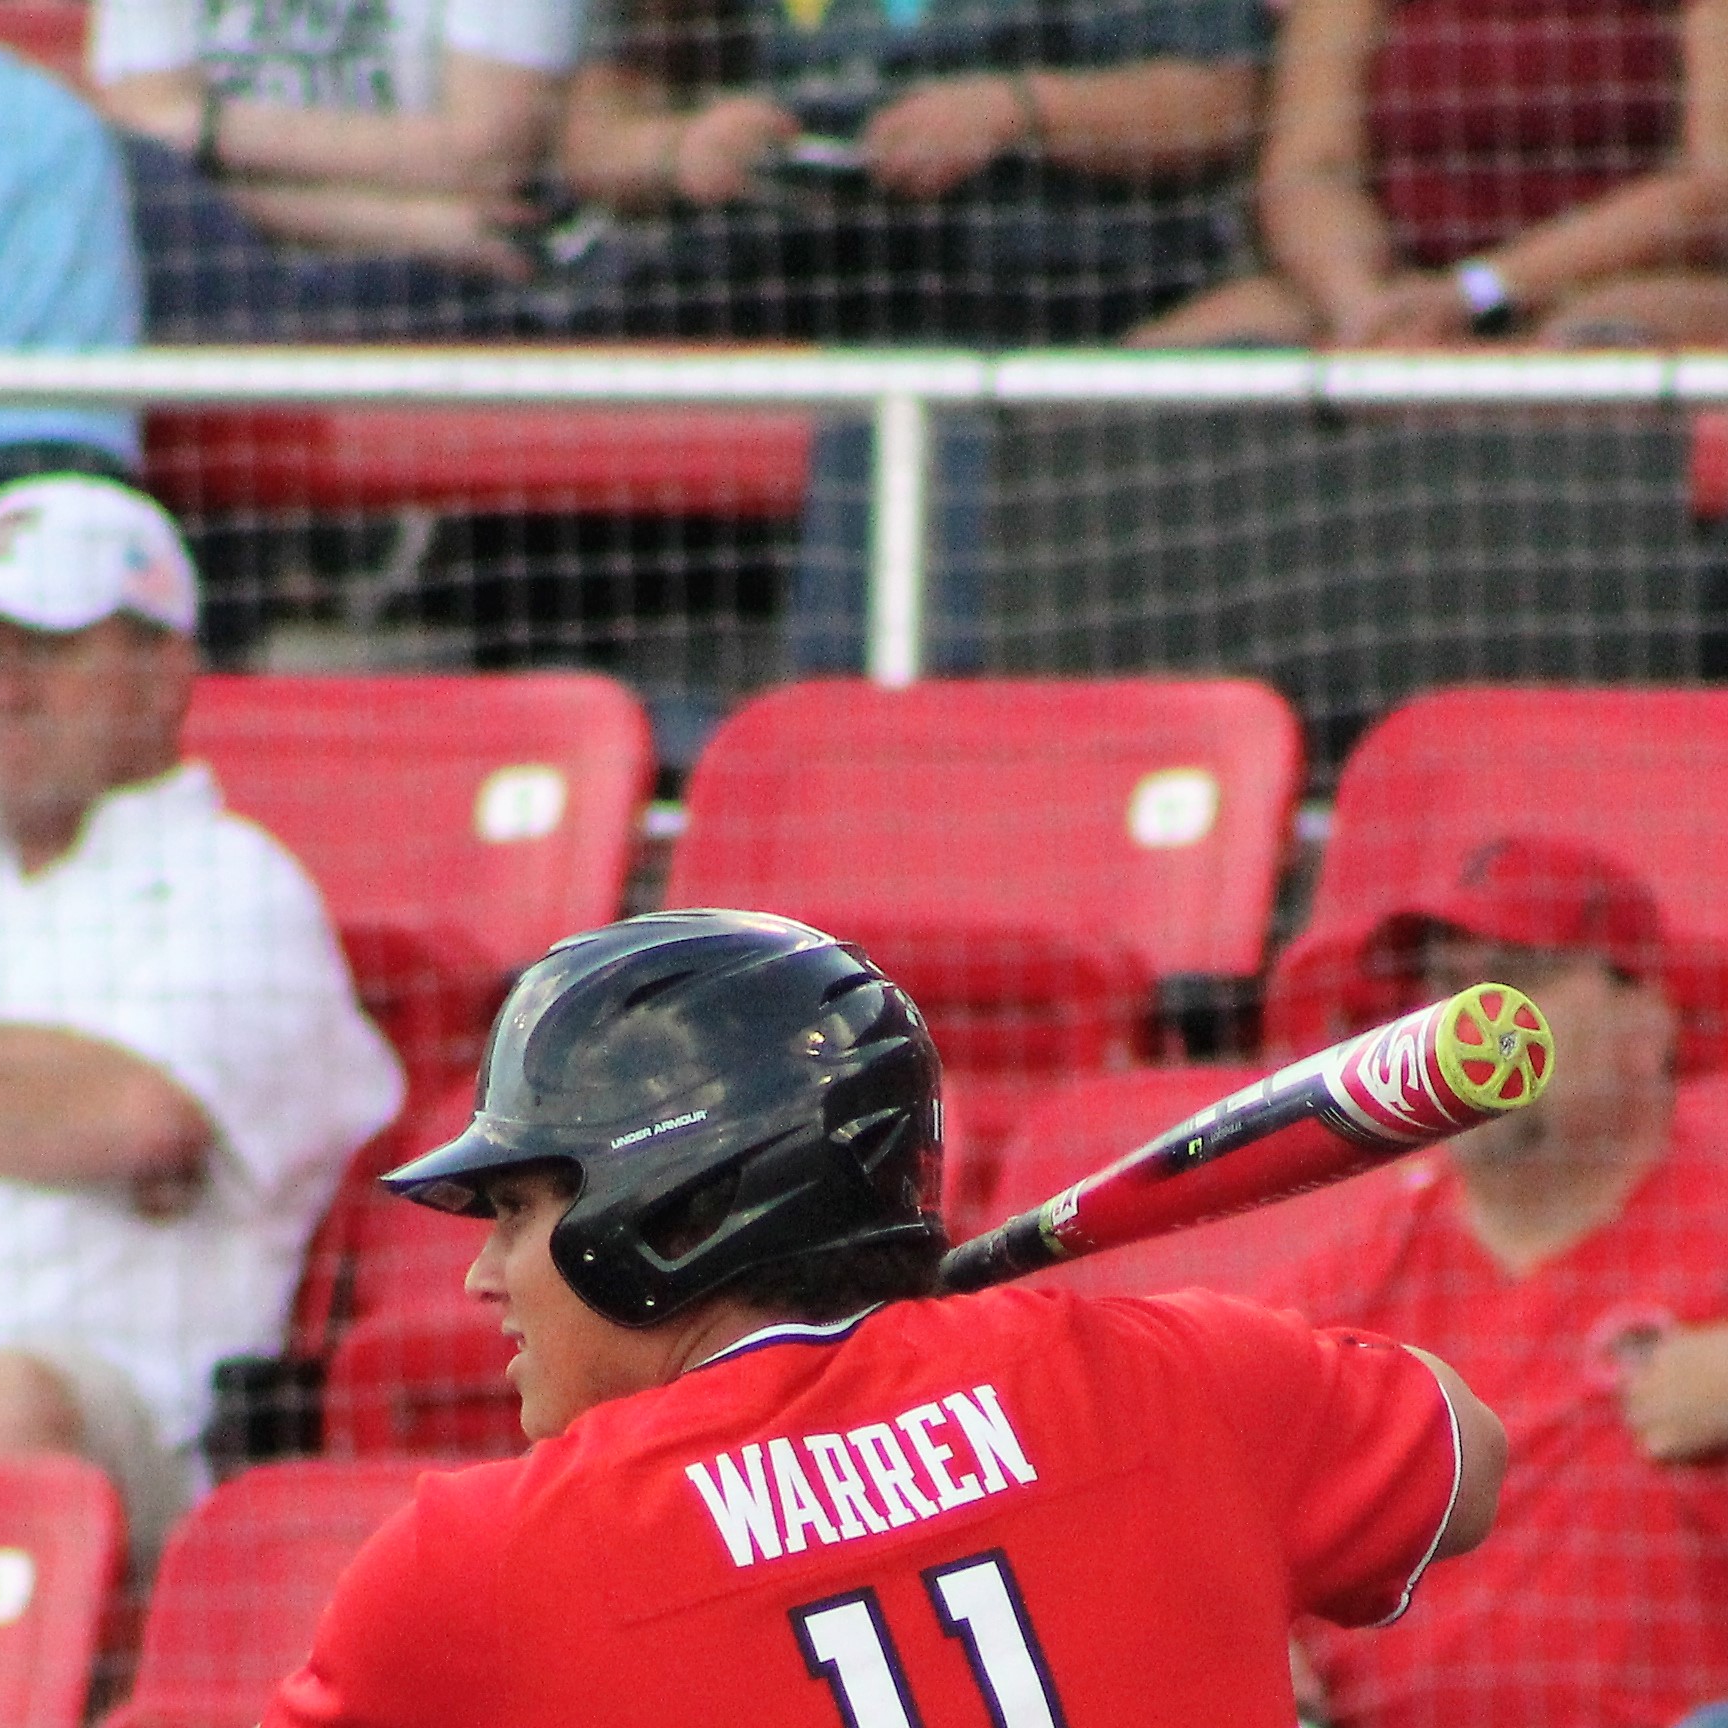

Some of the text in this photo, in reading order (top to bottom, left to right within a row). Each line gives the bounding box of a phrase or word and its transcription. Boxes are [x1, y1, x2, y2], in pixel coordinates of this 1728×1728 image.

[610, 1110, 707, 1150] UNDER ARMOUR
[685, 1383, 1039, 1567] WARREN
